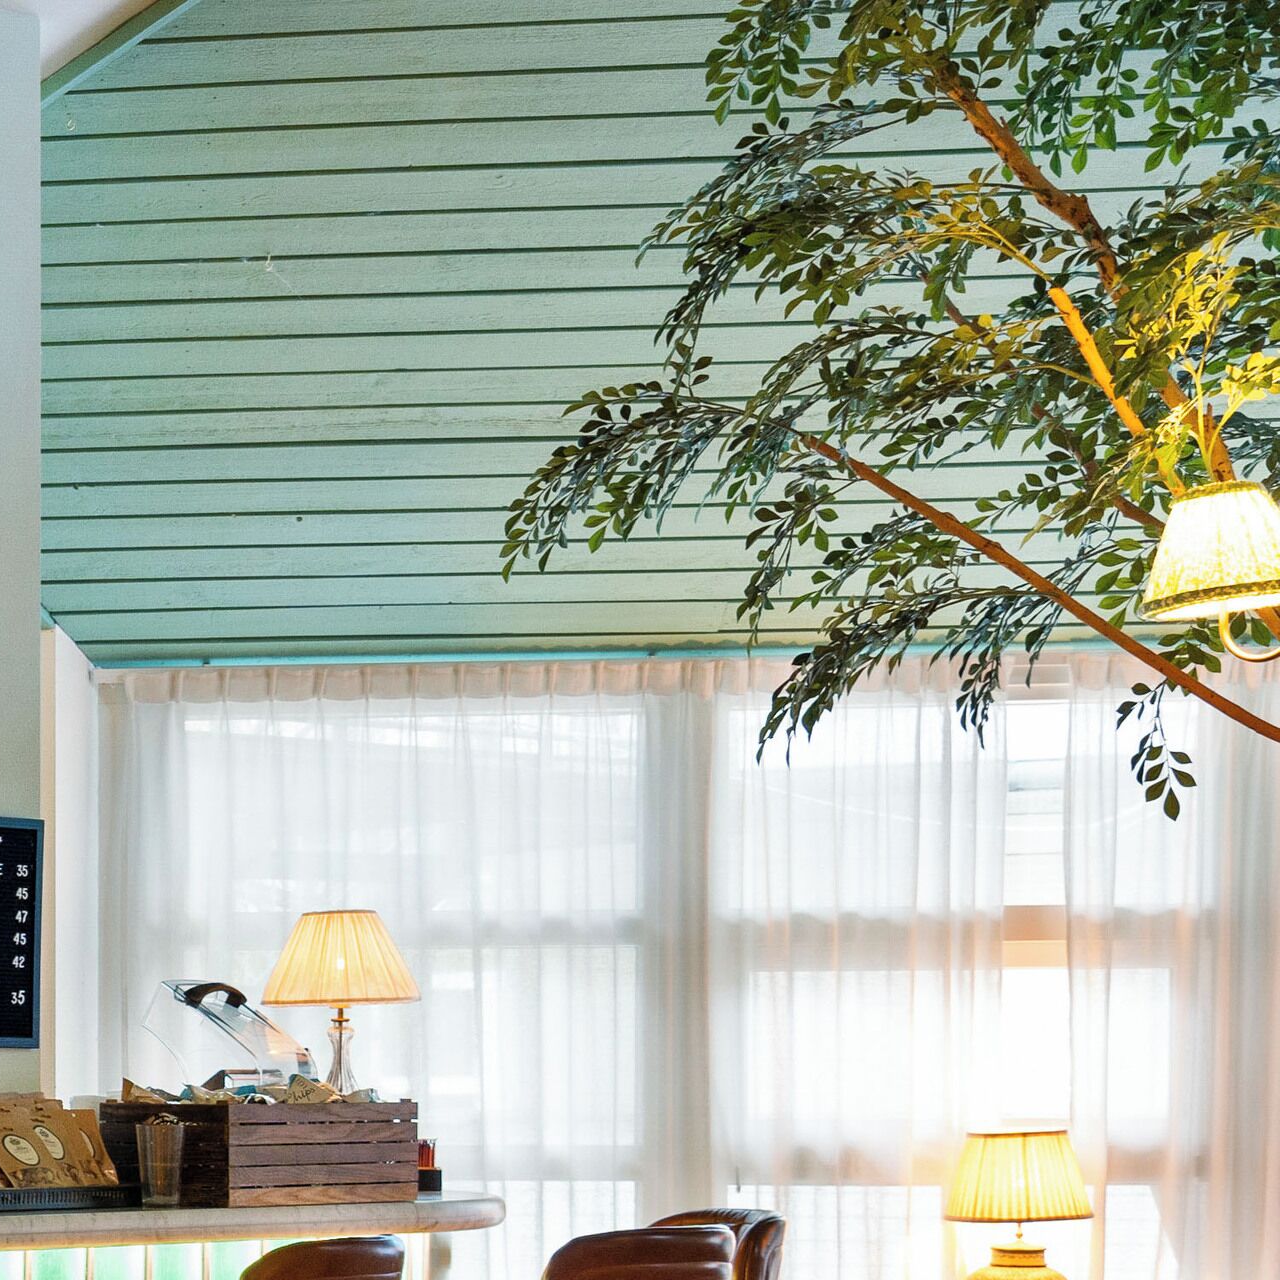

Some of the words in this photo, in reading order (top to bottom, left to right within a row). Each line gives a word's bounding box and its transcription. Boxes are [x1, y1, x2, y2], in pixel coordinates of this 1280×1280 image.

[16, 864, 29, 877] 35
[15, 887, 29, 900] 45
[15, 910, 29, 923] 47
[12, 932, 27, 945] 45
[11, 955, 26, 968] 42
[10, 990, 26, 1005] 35
